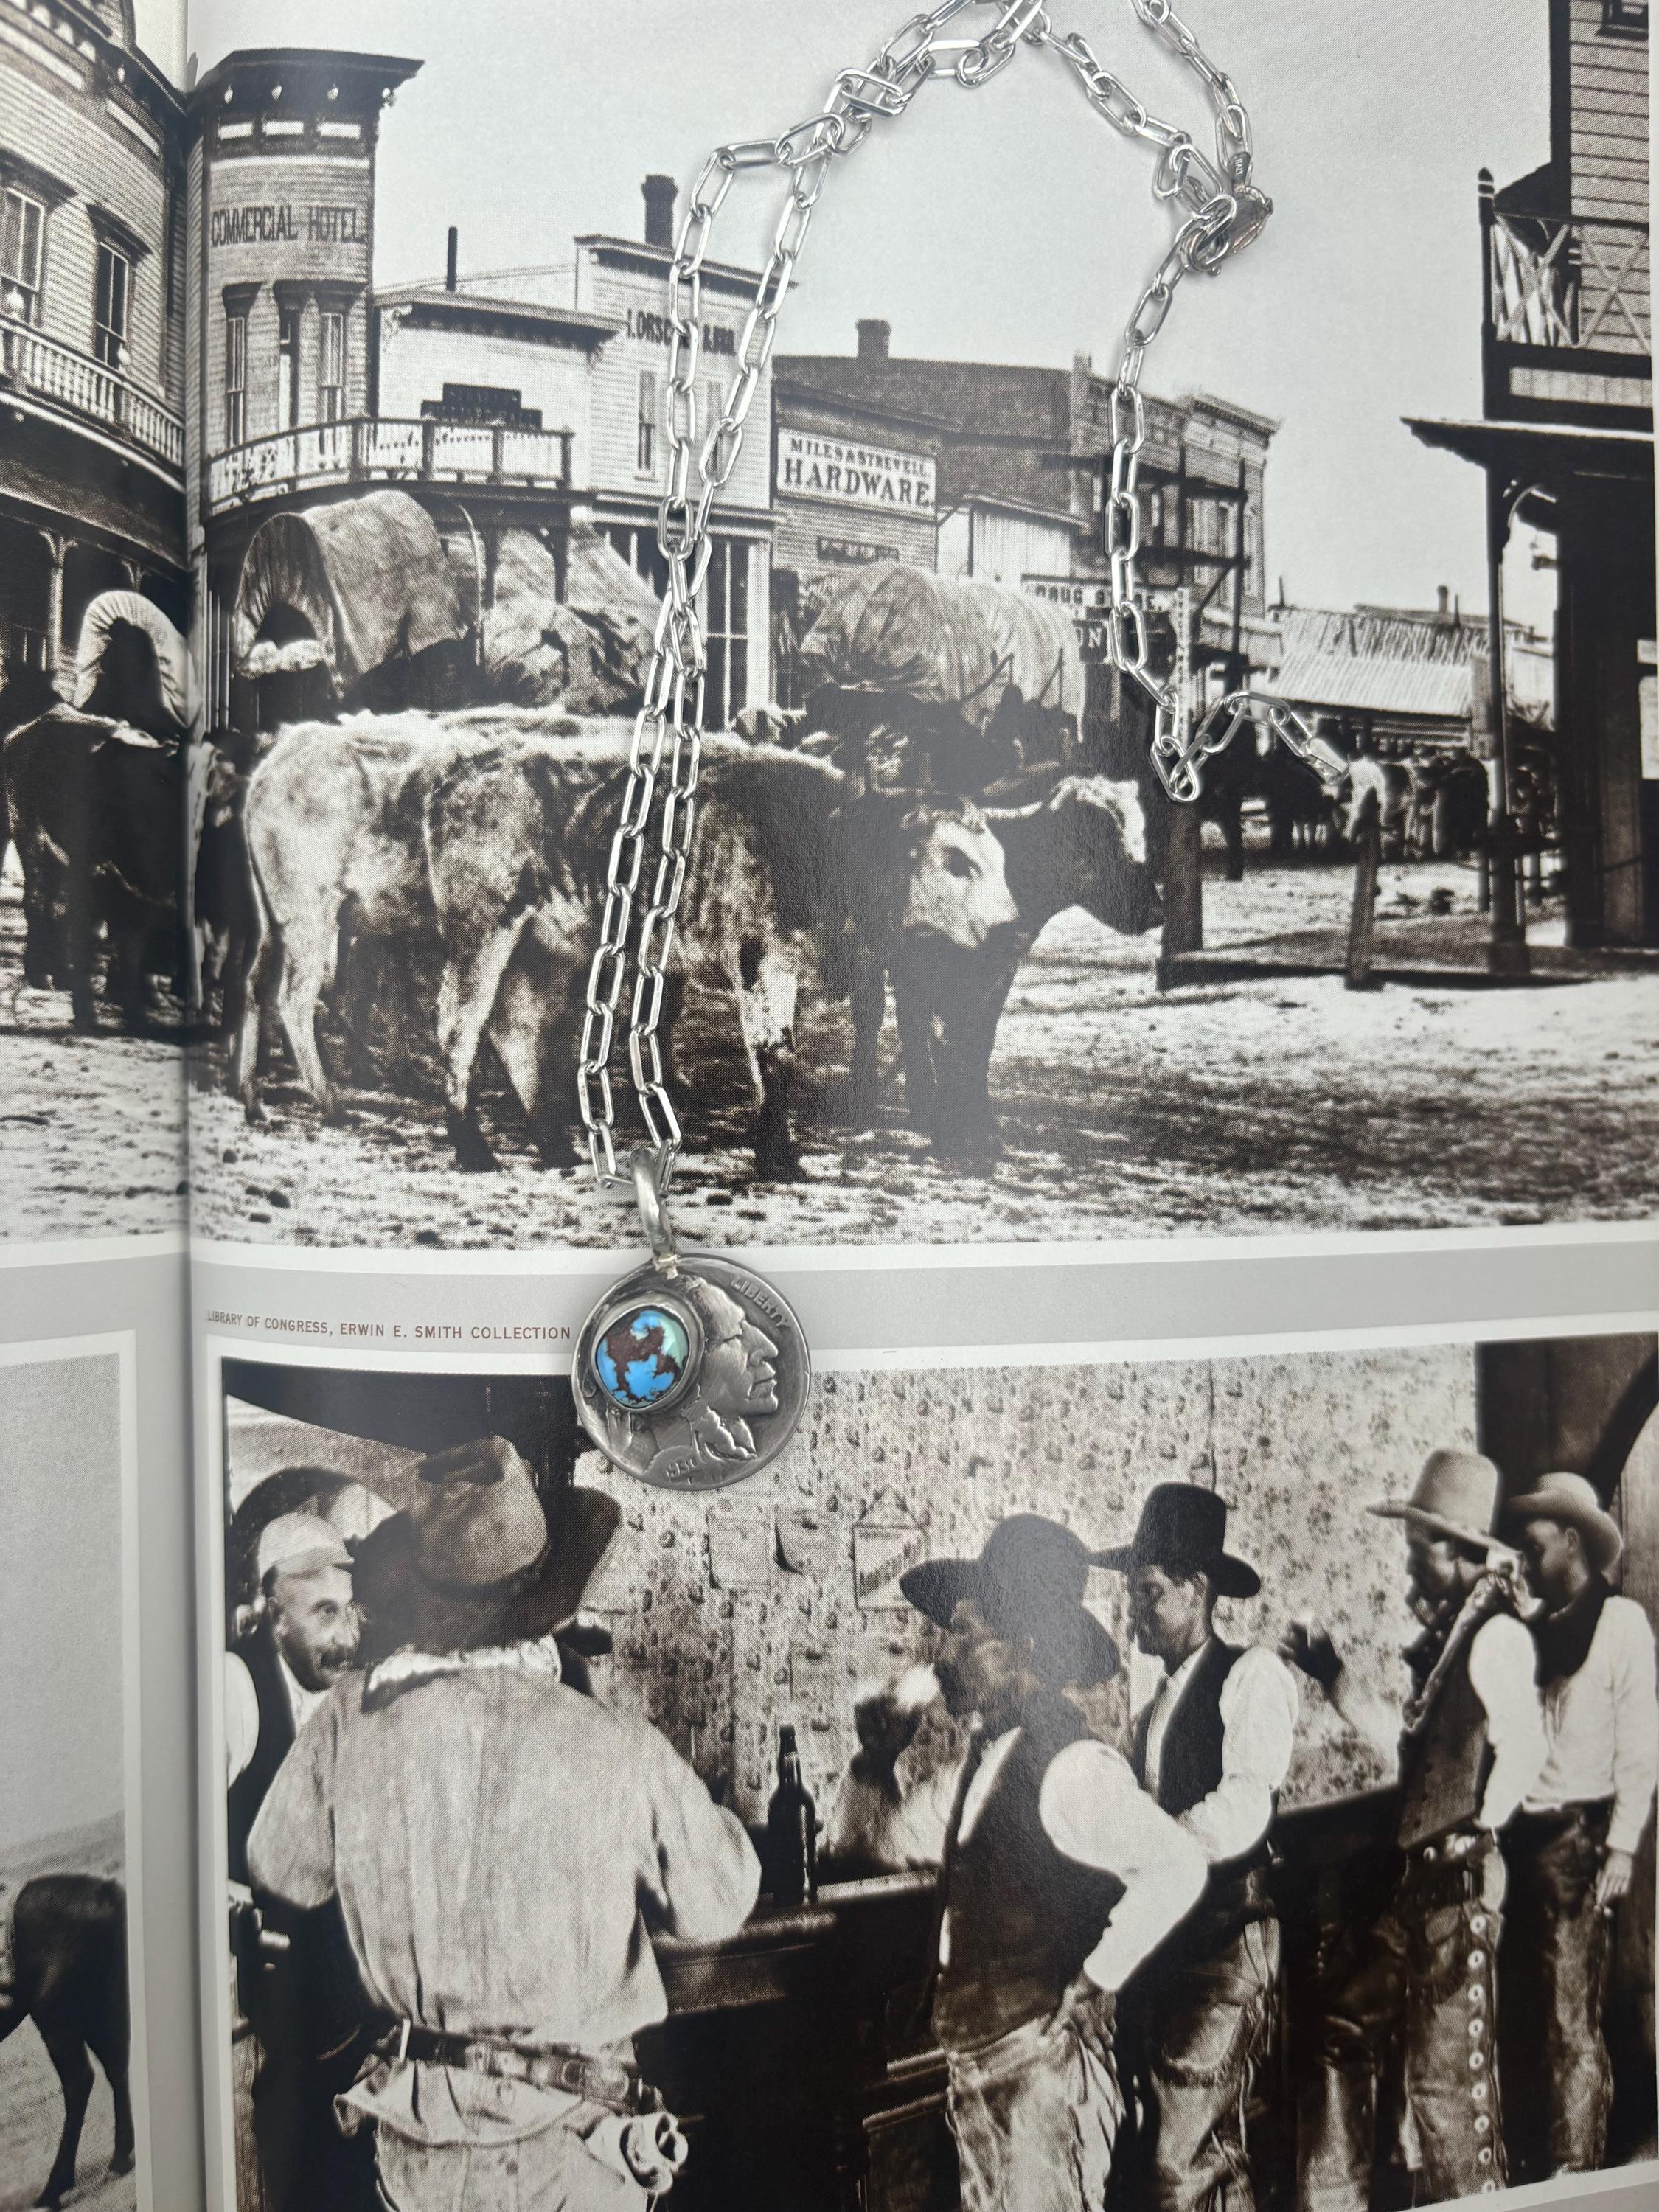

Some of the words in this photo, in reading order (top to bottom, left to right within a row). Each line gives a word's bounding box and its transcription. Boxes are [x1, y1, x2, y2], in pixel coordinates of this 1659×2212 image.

[212, 205, 298, 247] COMMERCIAL
[307, 206, 366, 243] HOTEL
[730, 1275, 793, 1327] LIBERTY
[207, 1309, 243, 1326] LIBRARY
[247, 1315, 260, 1328] OF
[265, 1318, 333, 1337] CONGRESS,
[340, 1323, 385, 1337] ERWIN
[393, 1325, 407, 1338] E.
[414, 1326, 462, 1339] SMITH
[470, 1326, 571, 1340] COLLECTION
